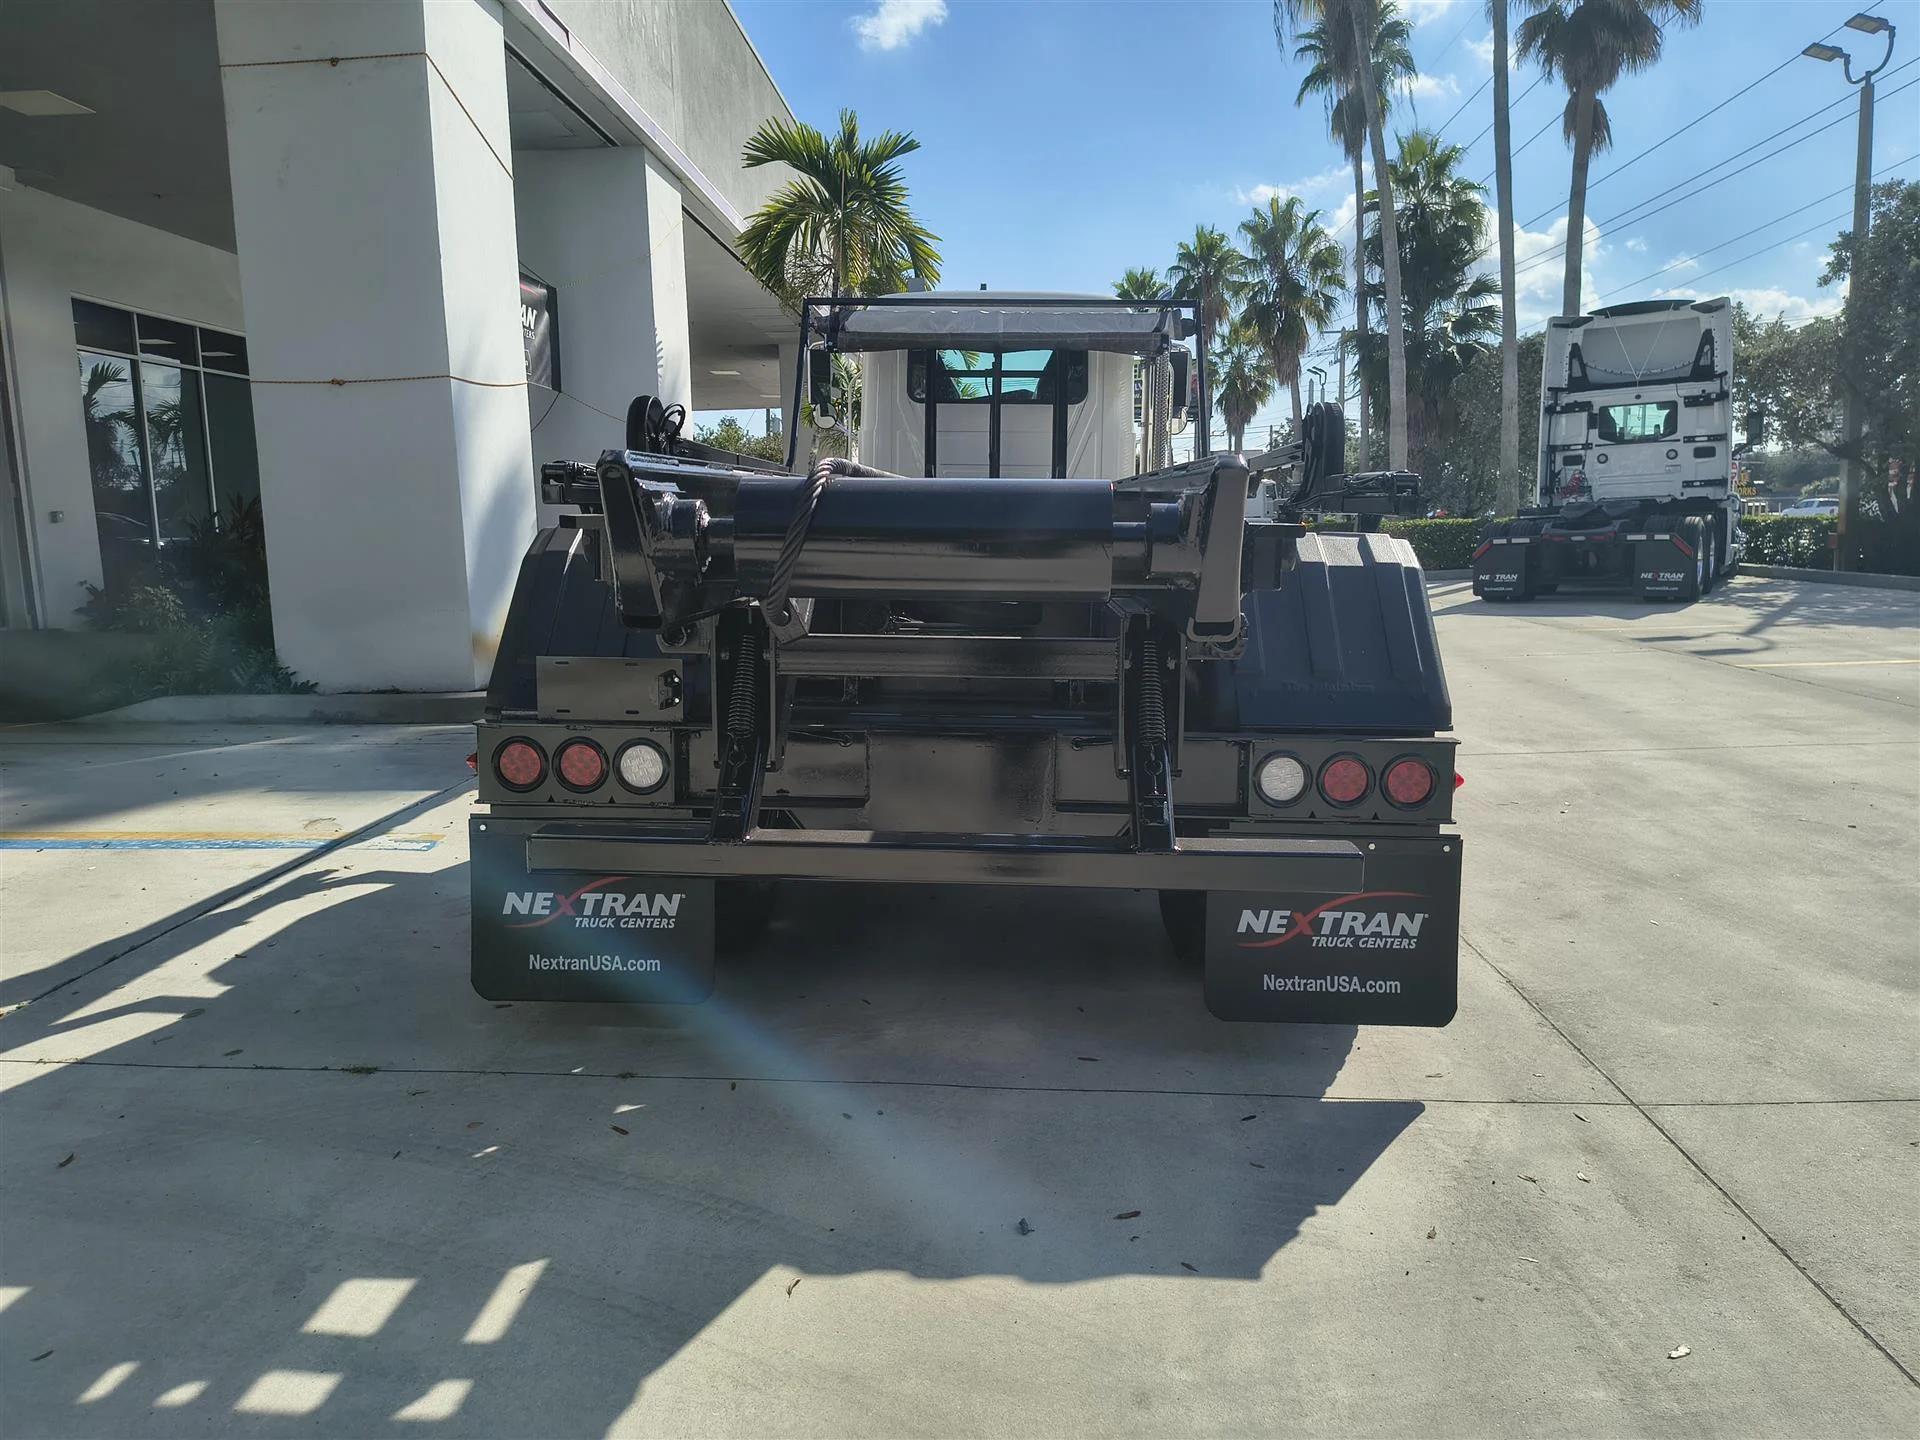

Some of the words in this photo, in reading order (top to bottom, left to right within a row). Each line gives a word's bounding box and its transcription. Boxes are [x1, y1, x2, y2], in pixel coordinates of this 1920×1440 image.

[502, 892, 682, 917] NEXTRAN
[574, 917, 615, 928] TRUCK
[620, 918, 676, 929] CENTERS
[1236, 909, 1425, 937] NEXTRAN
[1311, 936, 1354, 949] TRUCK
[1359, 937, 1417, 950] CENTERS
[529, 954, 661, 972] NextranUSA.com
[1263, 974, 1401, 994] NextranUSA.com
